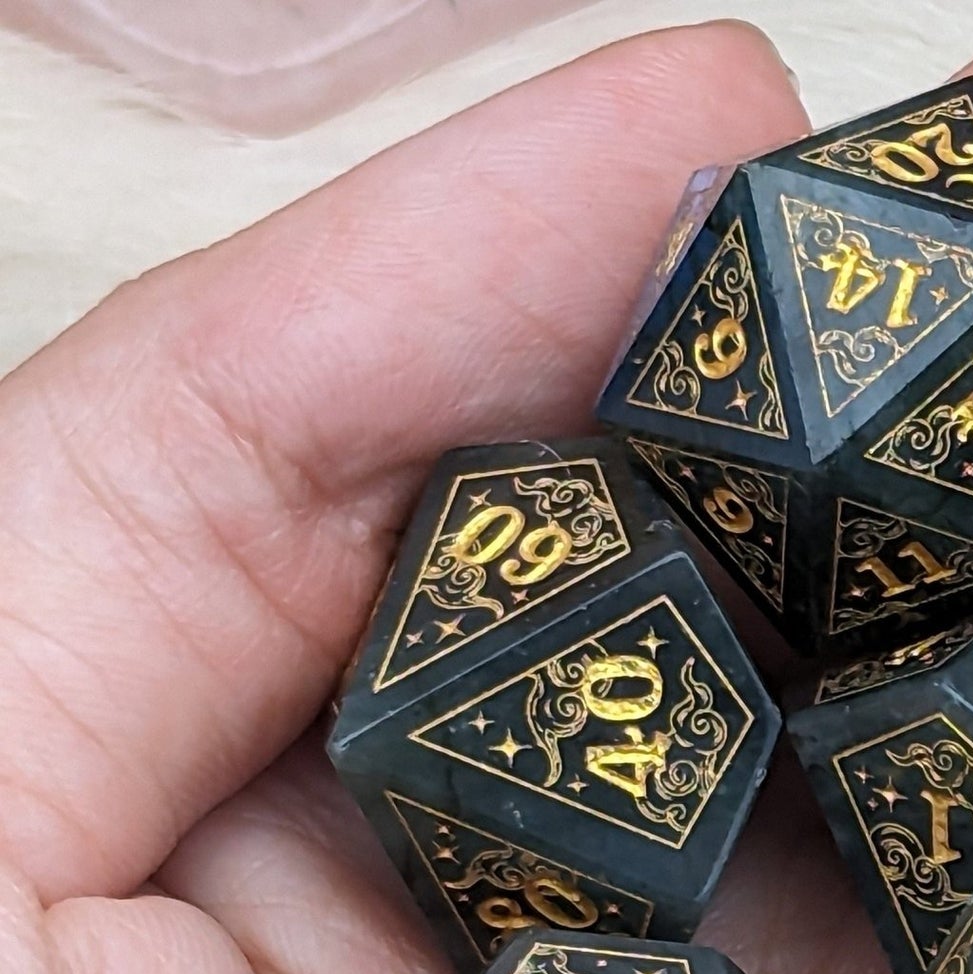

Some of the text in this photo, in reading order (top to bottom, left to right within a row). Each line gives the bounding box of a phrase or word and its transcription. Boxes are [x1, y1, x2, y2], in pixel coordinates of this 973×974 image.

[820, 240, 932, 329] 14
[855, 541, 958, 597] 11
[584, 654, 672, 798] 40
[919, 788, 961, 865] 1
